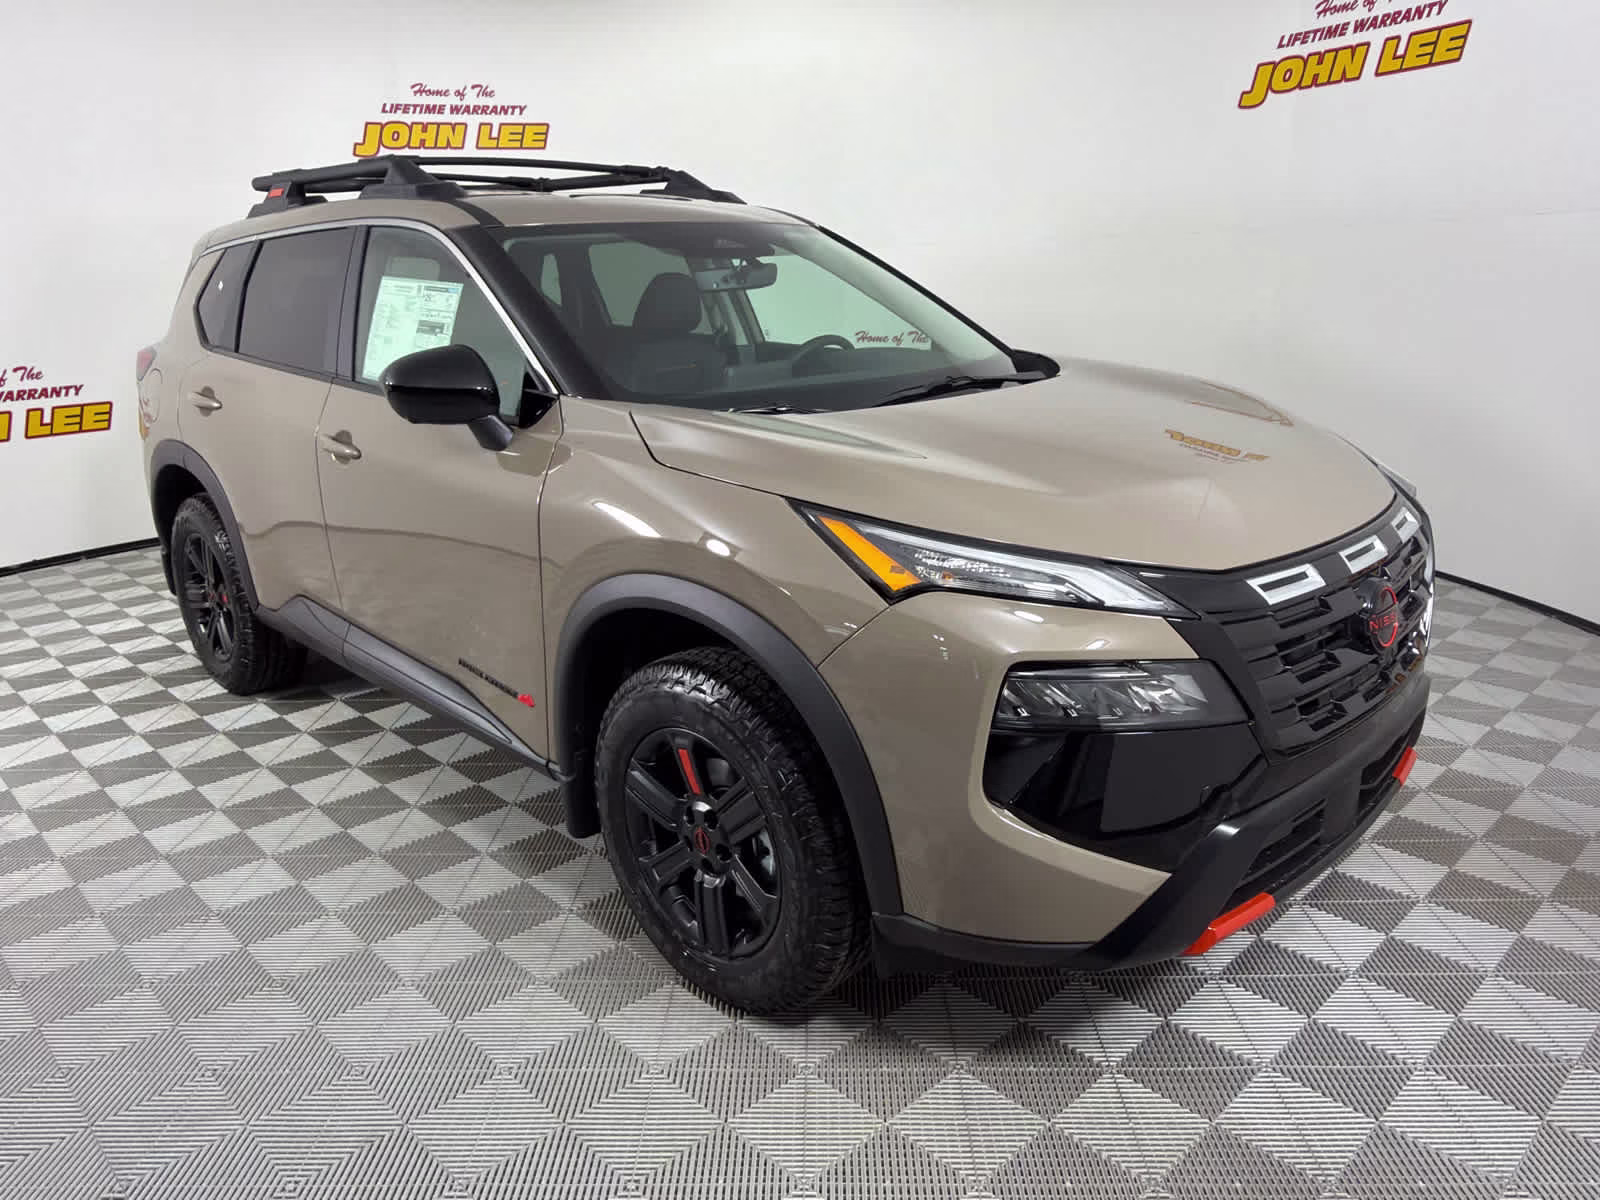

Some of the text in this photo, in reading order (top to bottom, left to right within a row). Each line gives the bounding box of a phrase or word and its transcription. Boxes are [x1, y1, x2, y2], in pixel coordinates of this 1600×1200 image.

[1314, 0, 1359, 19] Home
[1276, 0, 1449, 49] LIFETIME WARRANTY
[1237, 19, 1473, 110] JOHN LEE
[410, 82, 496, 101] Home of The
[381, 103, 527, 116] LIFETIME WARRANTY
[353, 121, 550, 158] JOHN LEE
[854, 330, 890, 343] Home
[891, 332, 905, 346] of
[12, 366, 43, 381] The
[0, 384, 84, 402] ARRANTY
[24, 401, 113, 440] LEE
